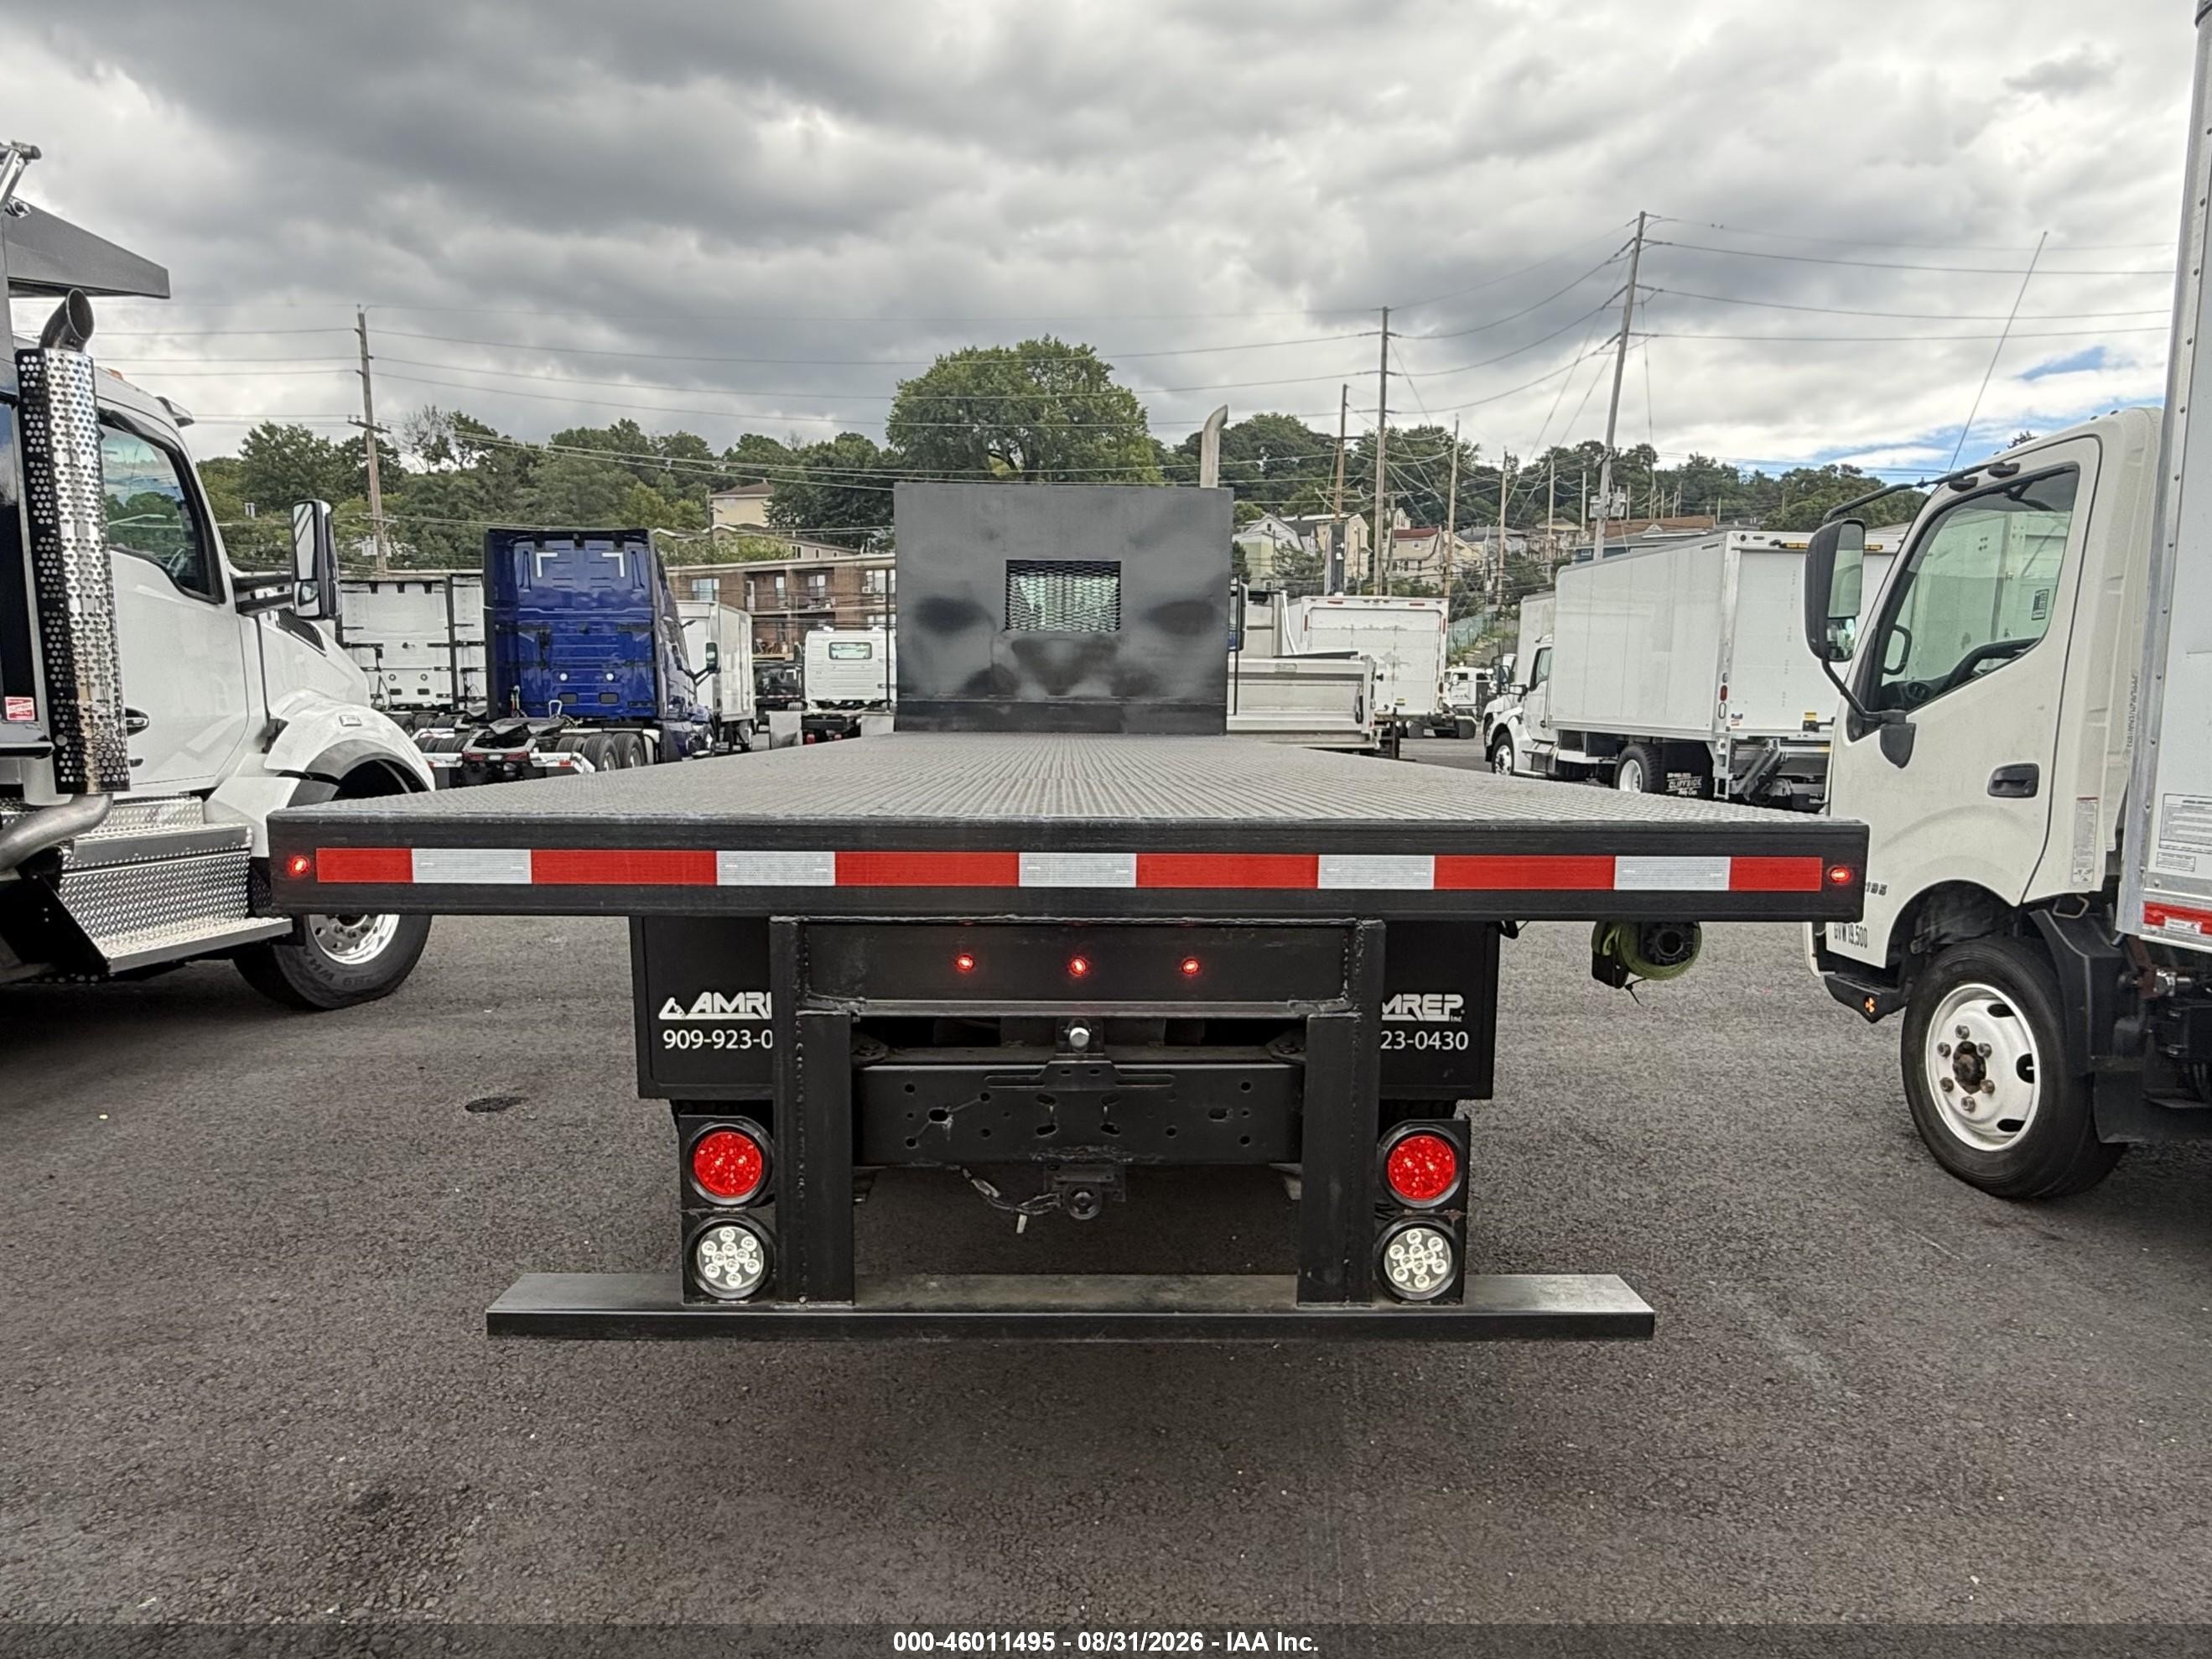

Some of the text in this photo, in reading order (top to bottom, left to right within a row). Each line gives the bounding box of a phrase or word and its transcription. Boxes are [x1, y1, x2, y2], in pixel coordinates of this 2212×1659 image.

[1848, 923, 1868, 949] 19,500
[662, 1029, 773, 1049] 909-923-0
[1380, 1030, 1469, 1050] 23-0430
